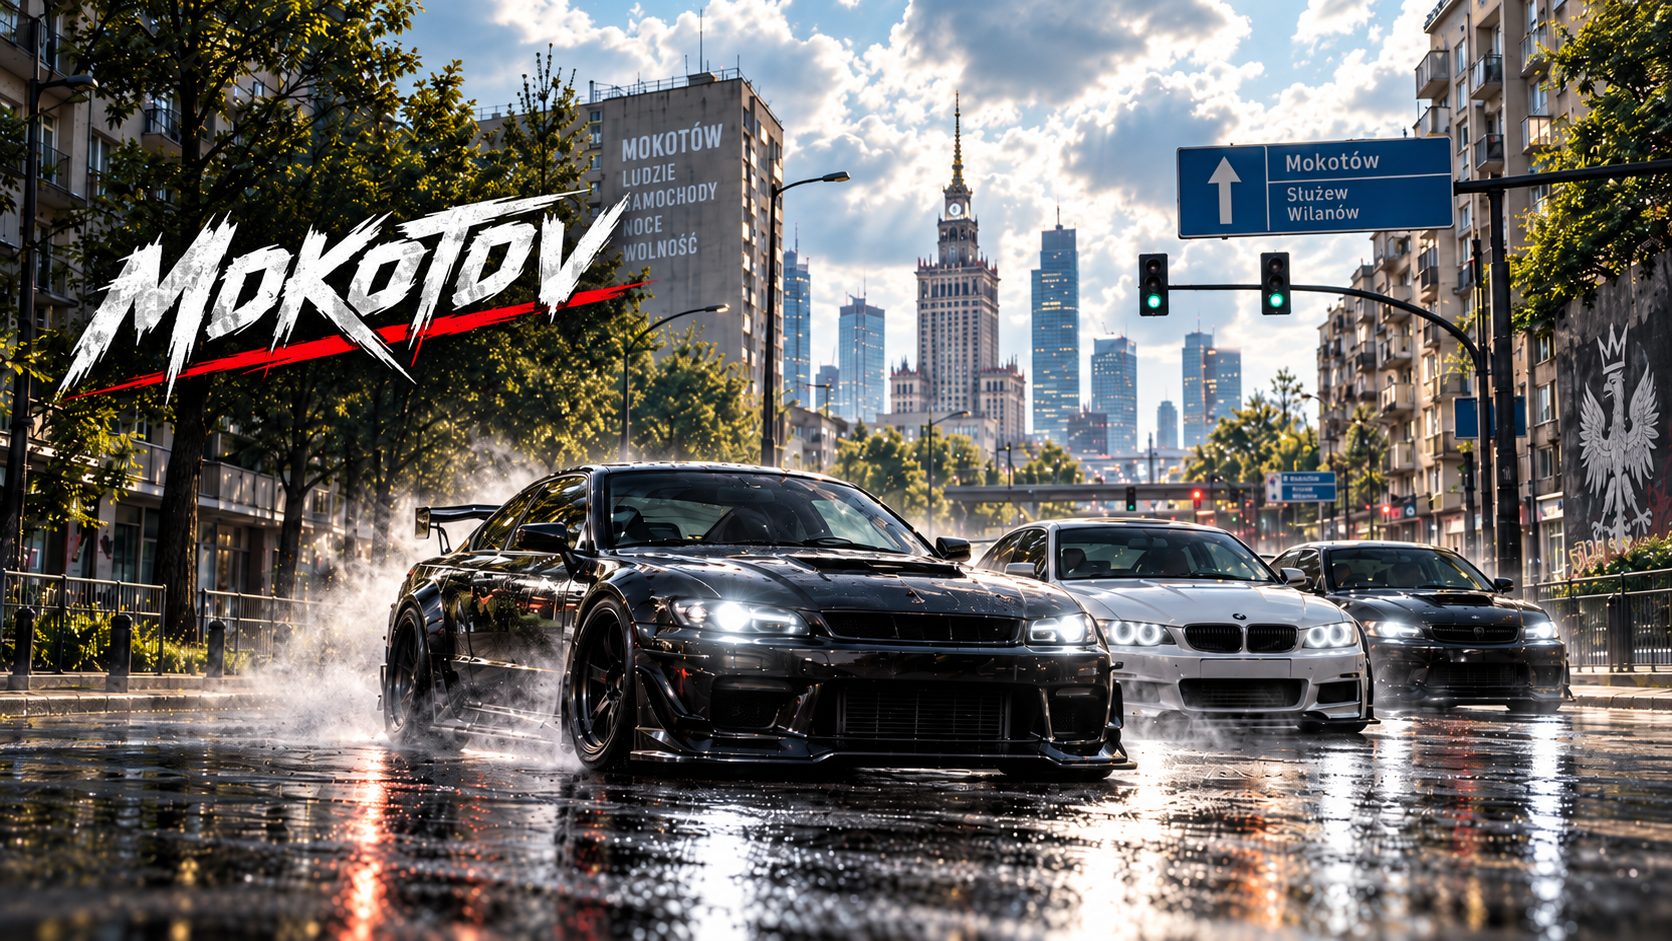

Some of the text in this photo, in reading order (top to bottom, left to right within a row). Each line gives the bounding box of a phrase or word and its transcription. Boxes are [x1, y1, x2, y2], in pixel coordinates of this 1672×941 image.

[622, 121, 723, 162] MOKOTÓW
[1285, 150, 1380, 173] Mokotów
[622, 163, 676, 188] LUDZIE
[1287, 185, 1348, 202] Służew
[1287, 204, 1360, 222] Wilanów
[623, 215, 663, 237] NOCE
[623, 232, 698, 262] WOLNOŚĆ
